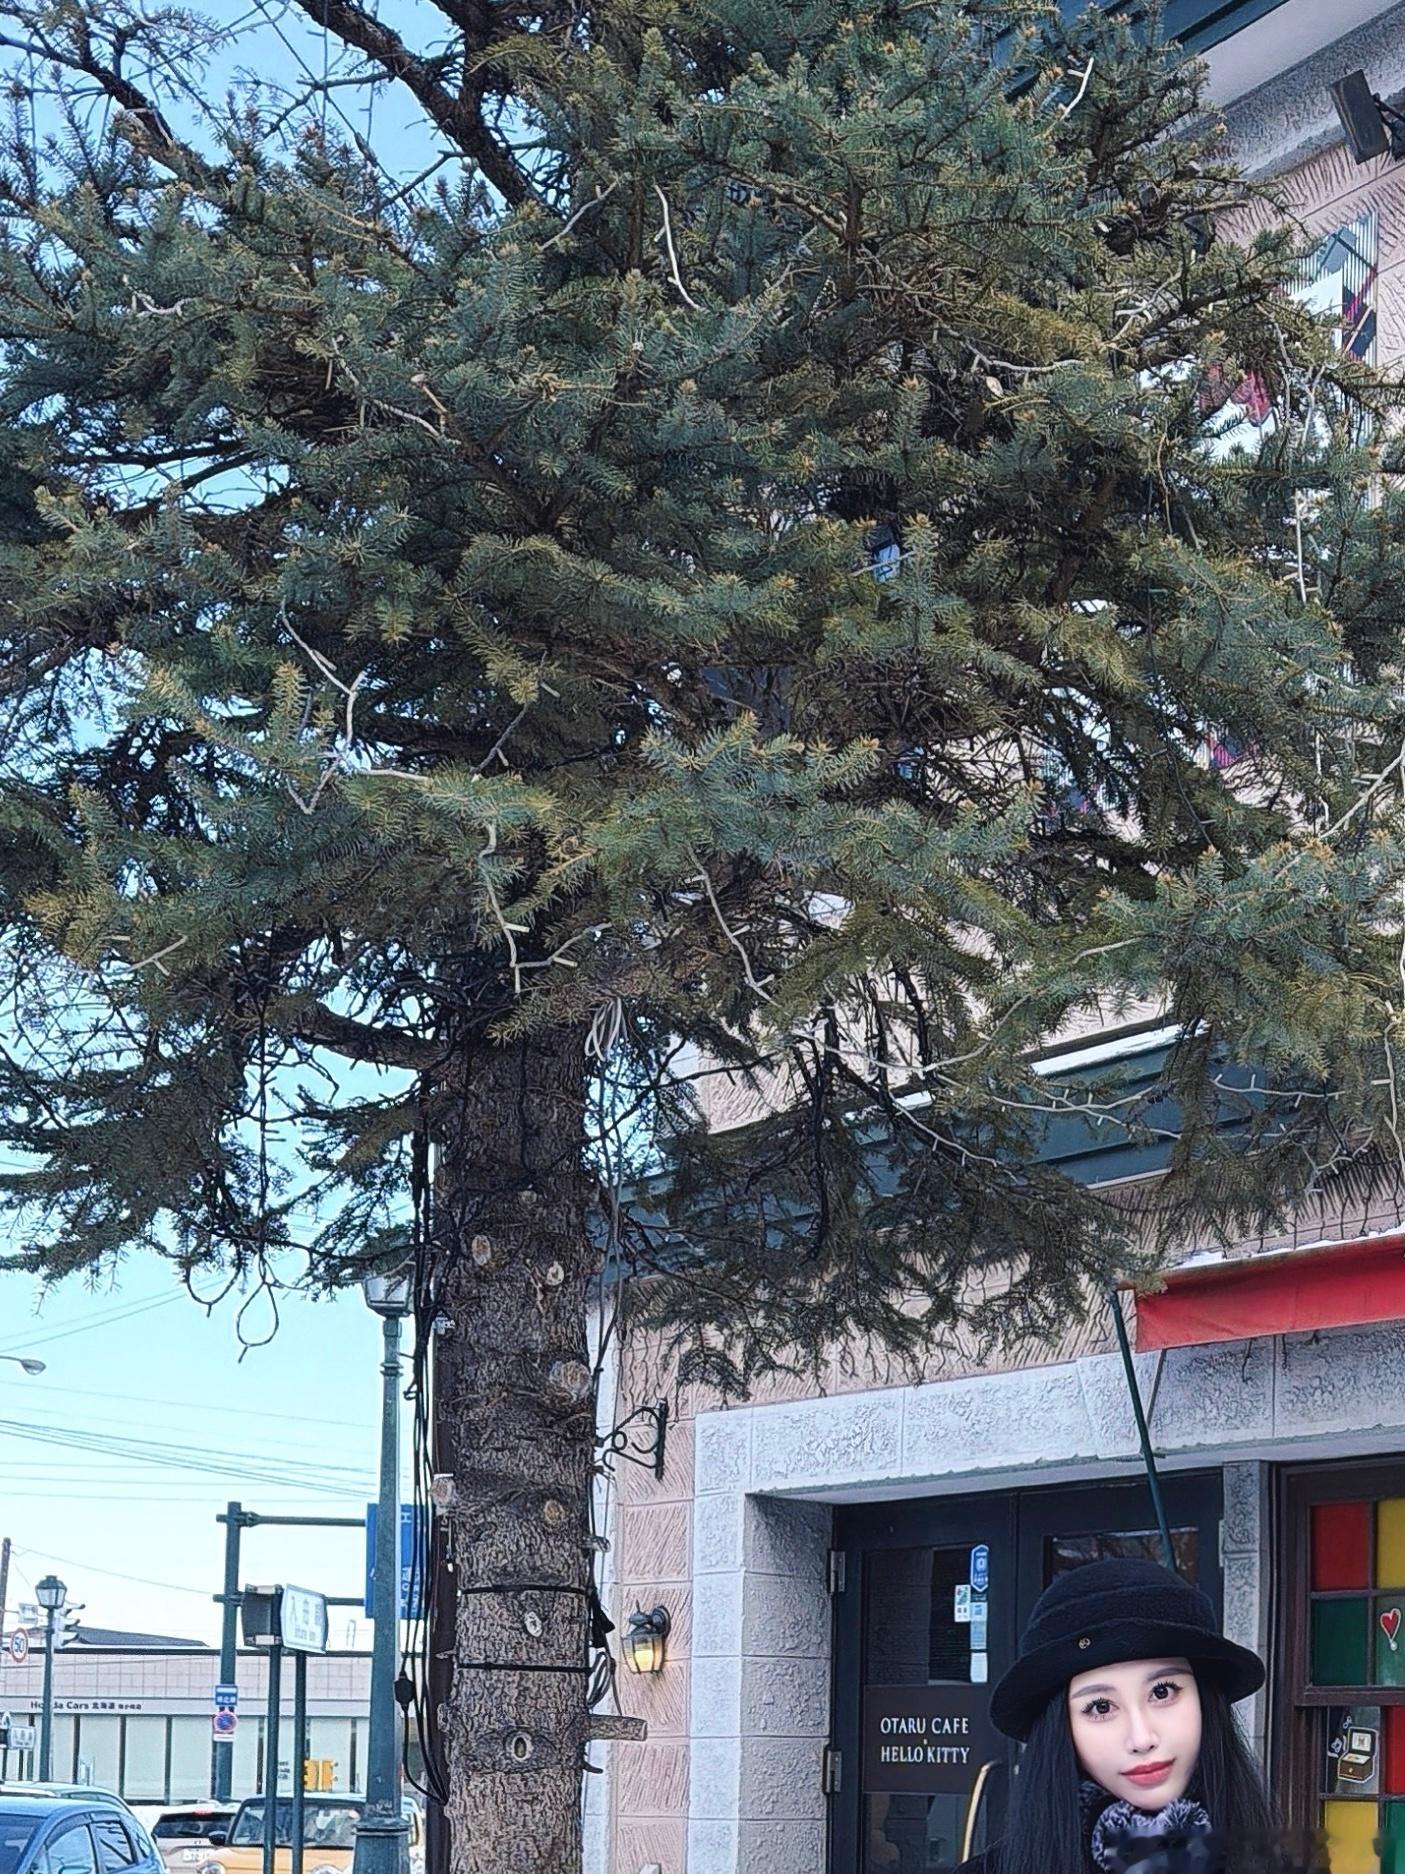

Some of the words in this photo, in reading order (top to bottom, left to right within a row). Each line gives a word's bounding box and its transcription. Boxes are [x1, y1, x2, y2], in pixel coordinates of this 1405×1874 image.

[30, 1701, 63, 1710] Hoda
[67, 1701, 89, 1710] Cars
[880, 1717, 926, 1734] OTARU
[931, 1717, 969, 1734] CAFE
[881, 1746, 924, 1763] HELLO
[927, 1746, 970, 1764] KITTY
